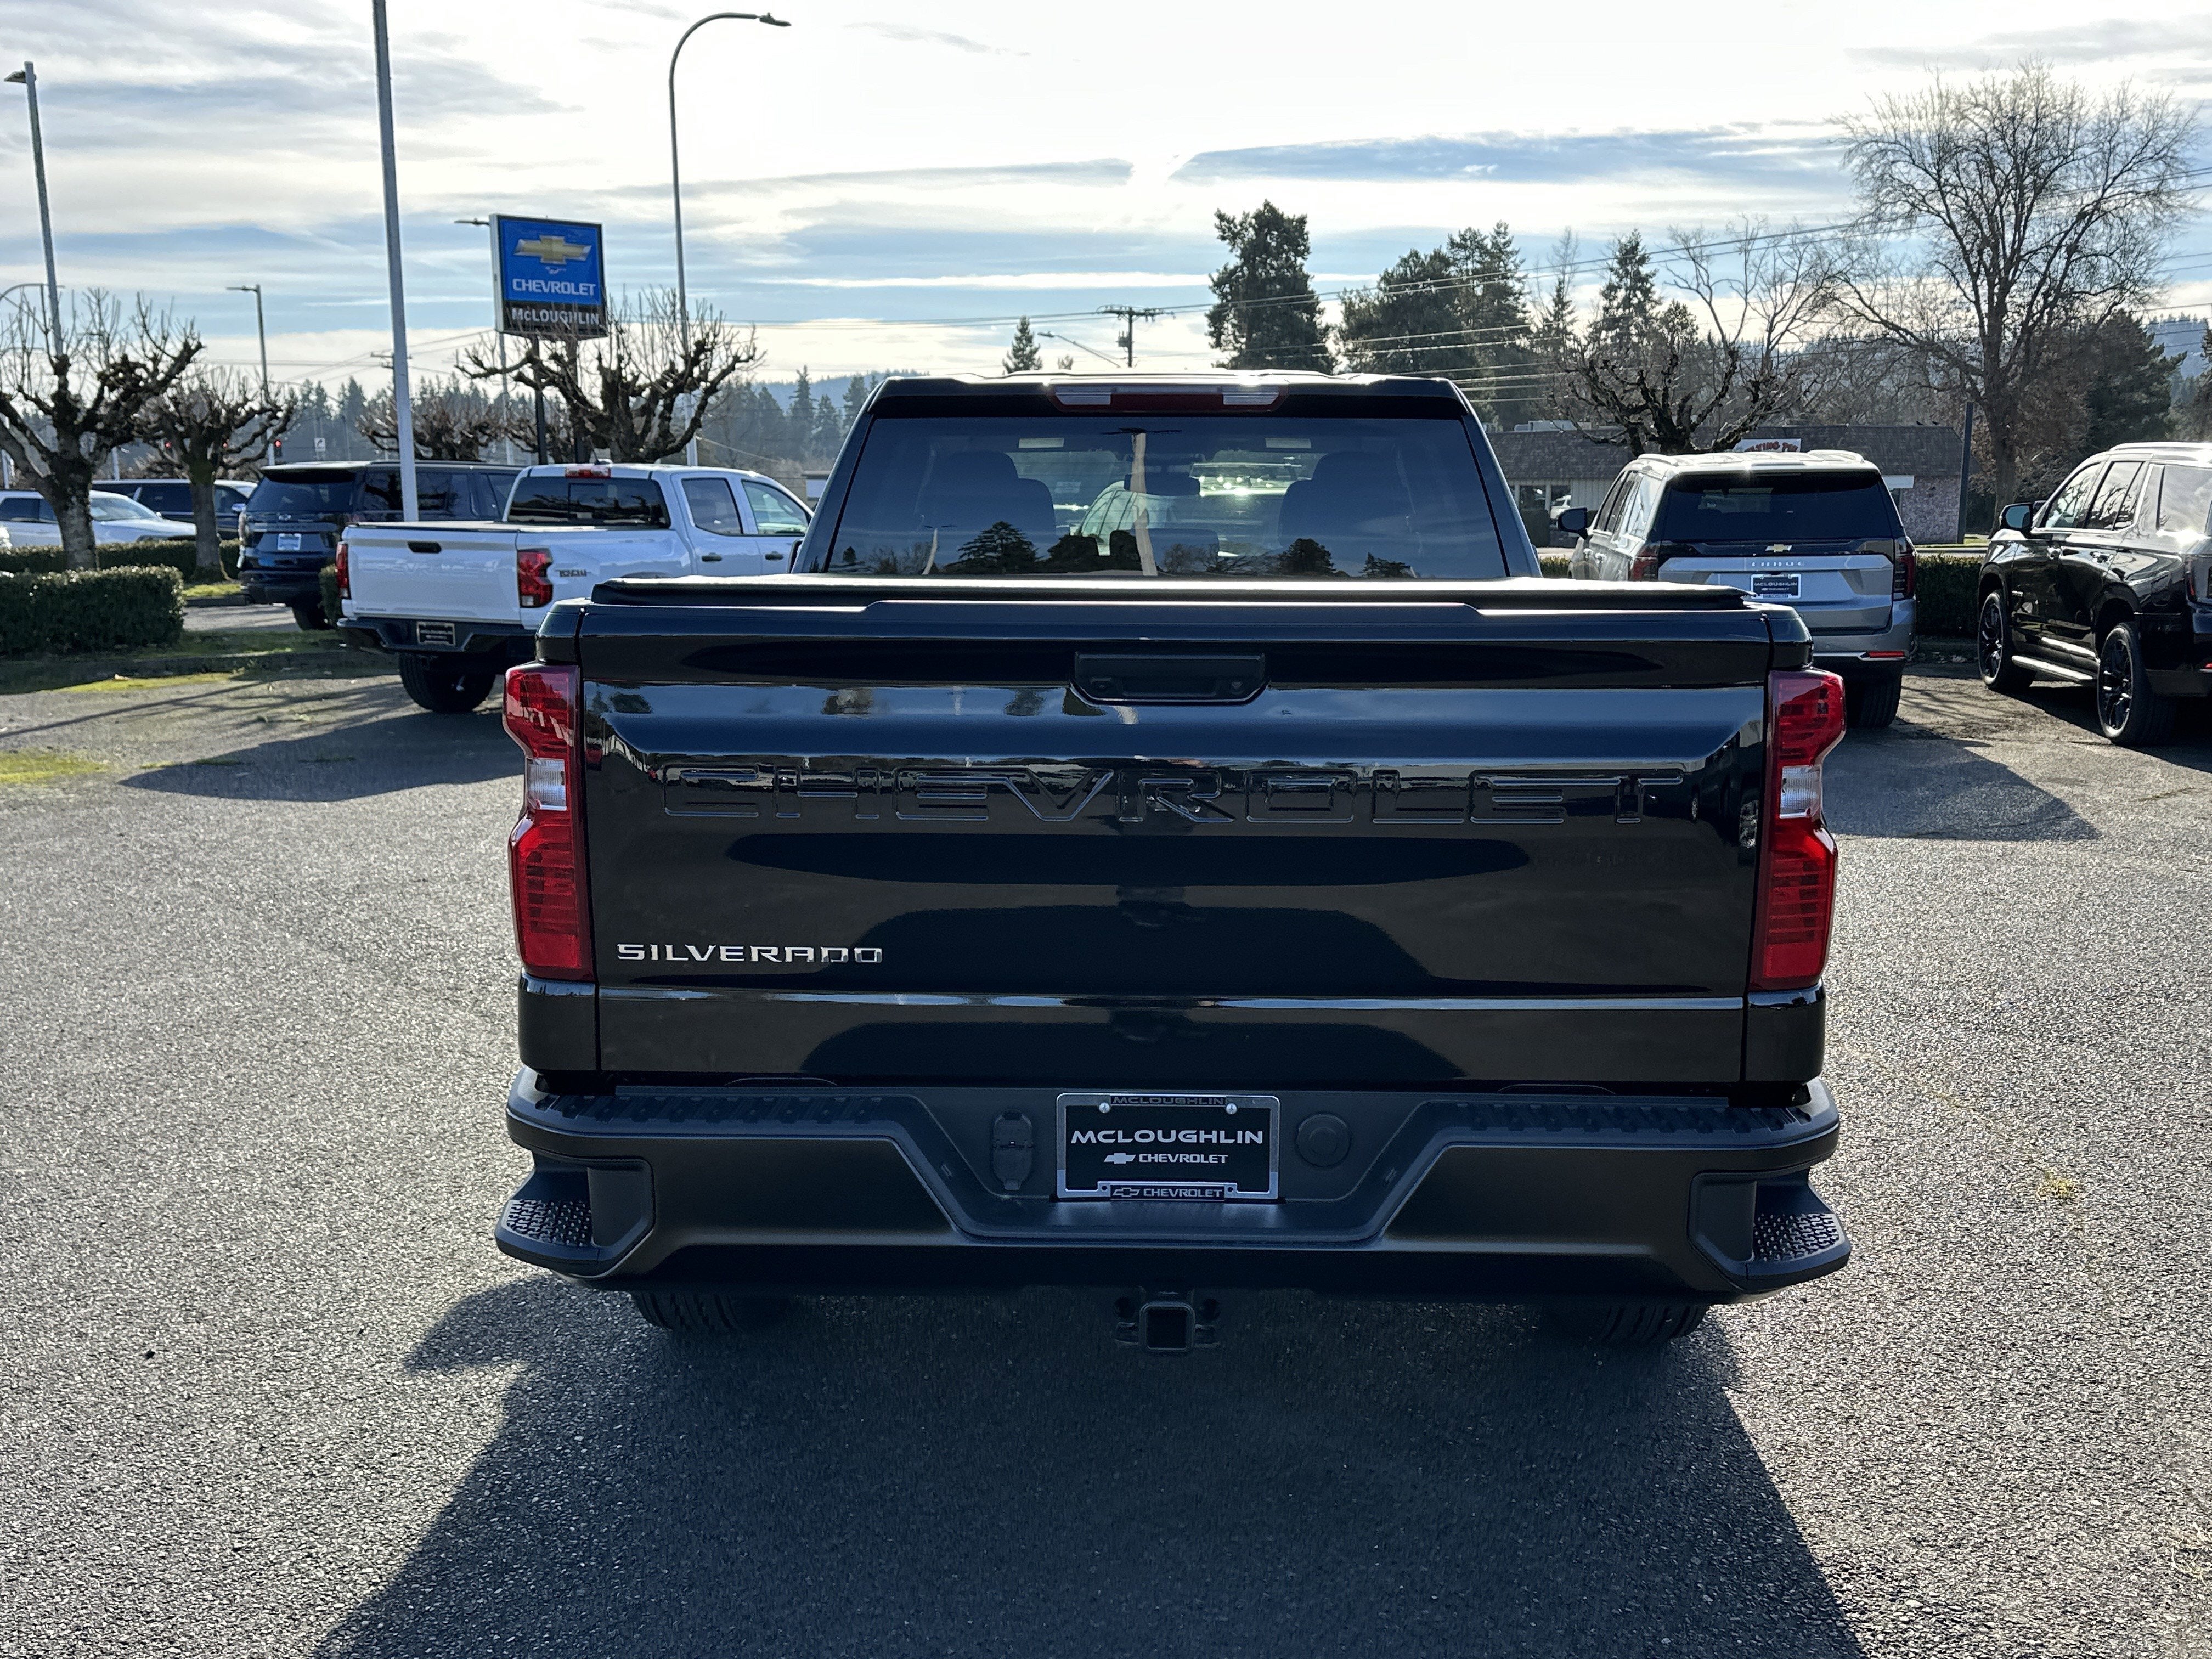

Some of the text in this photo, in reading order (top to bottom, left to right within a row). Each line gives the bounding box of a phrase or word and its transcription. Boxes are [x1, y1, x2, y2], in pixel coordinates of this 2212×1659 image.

[512, 278, 596, 296] CHEVROLET
[662, 765, 1684, 823] CHEVROLET
[617, 943, 883, 963] SILVERADO
[1113, 1097, 1224, 1105] MCLOUGHLIN
[1070, 1130, 1263, 1144] MCLOUGHLIN
[1138, 1153, 1229, 1164] CHEVROLET
[1143, 1188, 1223, 1198] CHEVROLET
